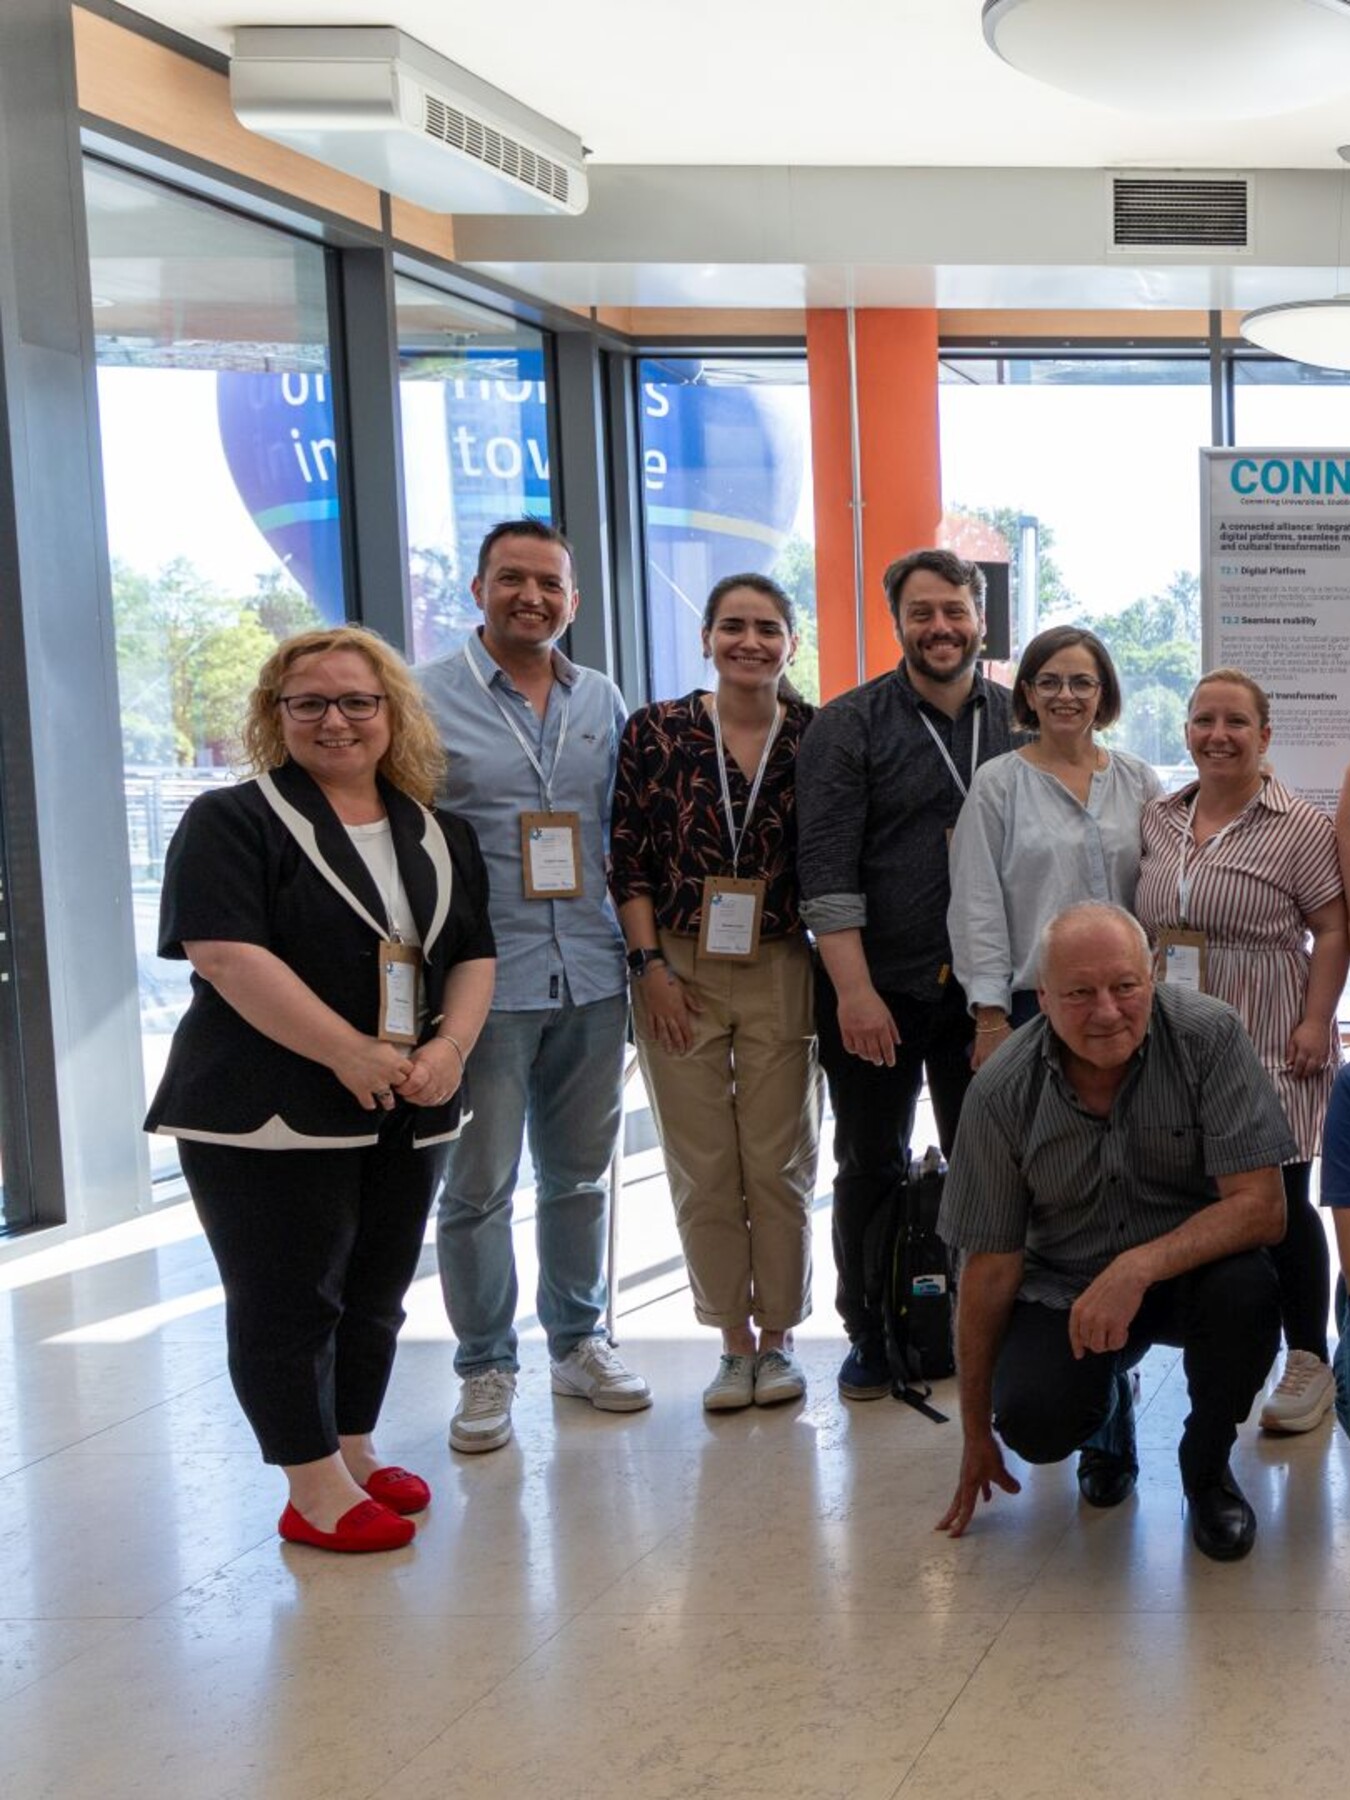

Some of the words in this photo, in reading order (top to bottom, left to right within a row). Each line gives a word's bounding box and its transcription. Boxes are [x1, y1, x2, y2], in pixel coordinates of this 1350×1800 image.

[1219, 523, 1227, 531] A
[1228, 522, 1275, 532] connected
[1219, 532, 1248, 543] digital
[1220, 542, 1236, 551] and
[1238, 542, 1272, 551] cultural
[1274, 542, 1341, 551] transformation
[1240, 566, 1268, 577] Digital
[1269, 566, 1306, 576] Platform
[1241, 616, 1281, 626] Seamless
[1282, 616, 1317, 627] mobility
[1275, 692, 1338, 701] transformation
